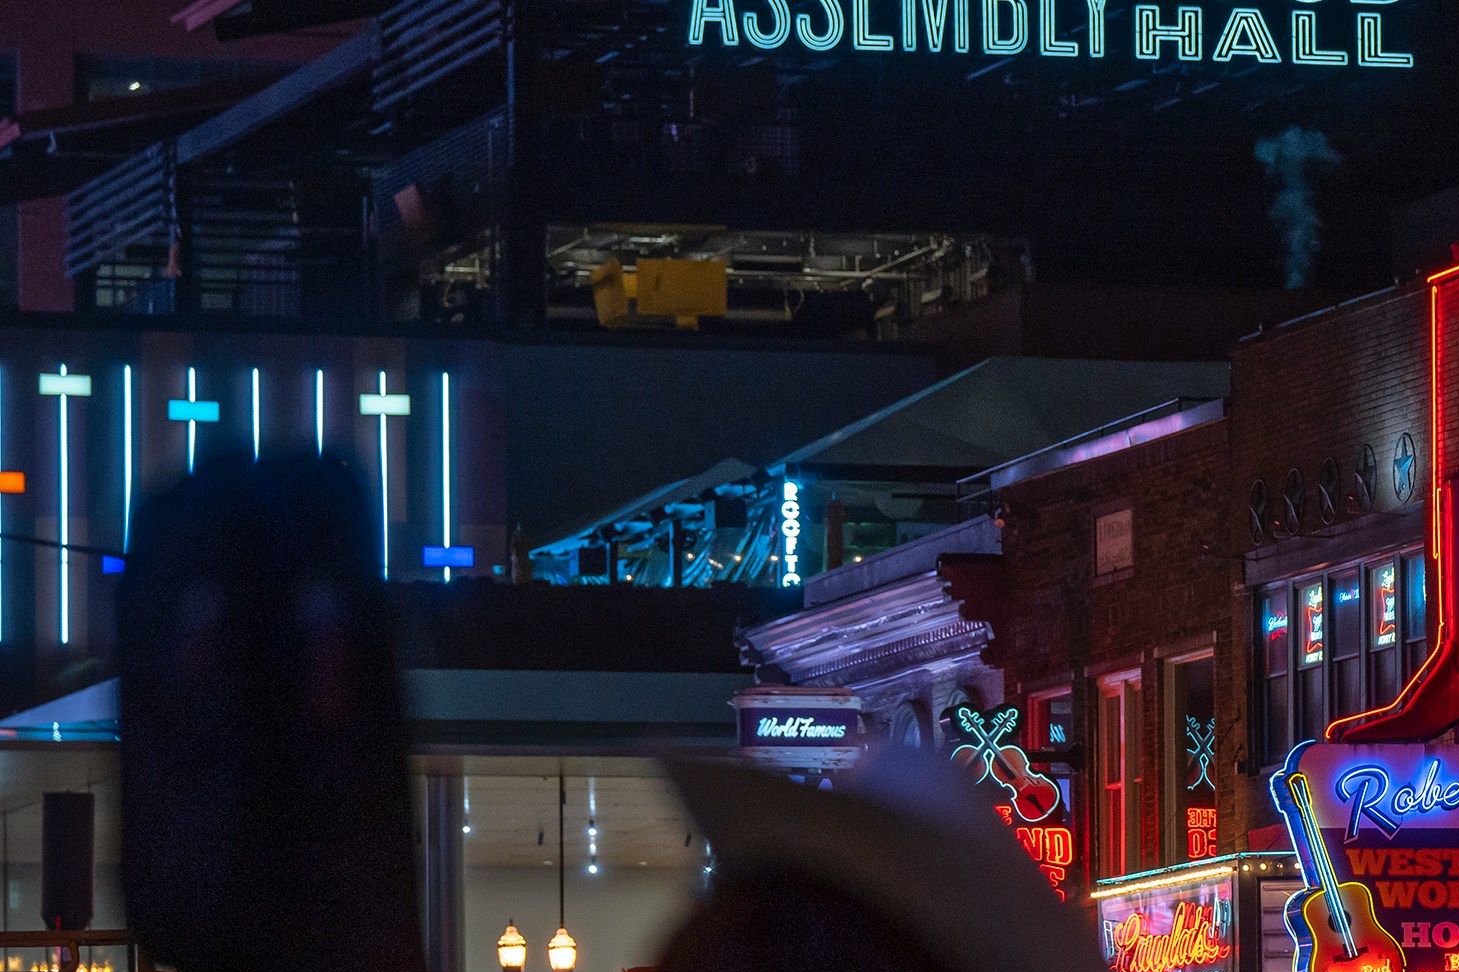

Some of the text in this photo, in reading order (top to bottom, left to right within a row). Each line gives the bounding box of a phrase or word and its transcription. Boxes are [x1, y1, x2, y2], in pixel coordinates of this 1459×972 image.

[1135, 5, 1413, 66] HALL
[757, 717, 846, 738] World Famous
